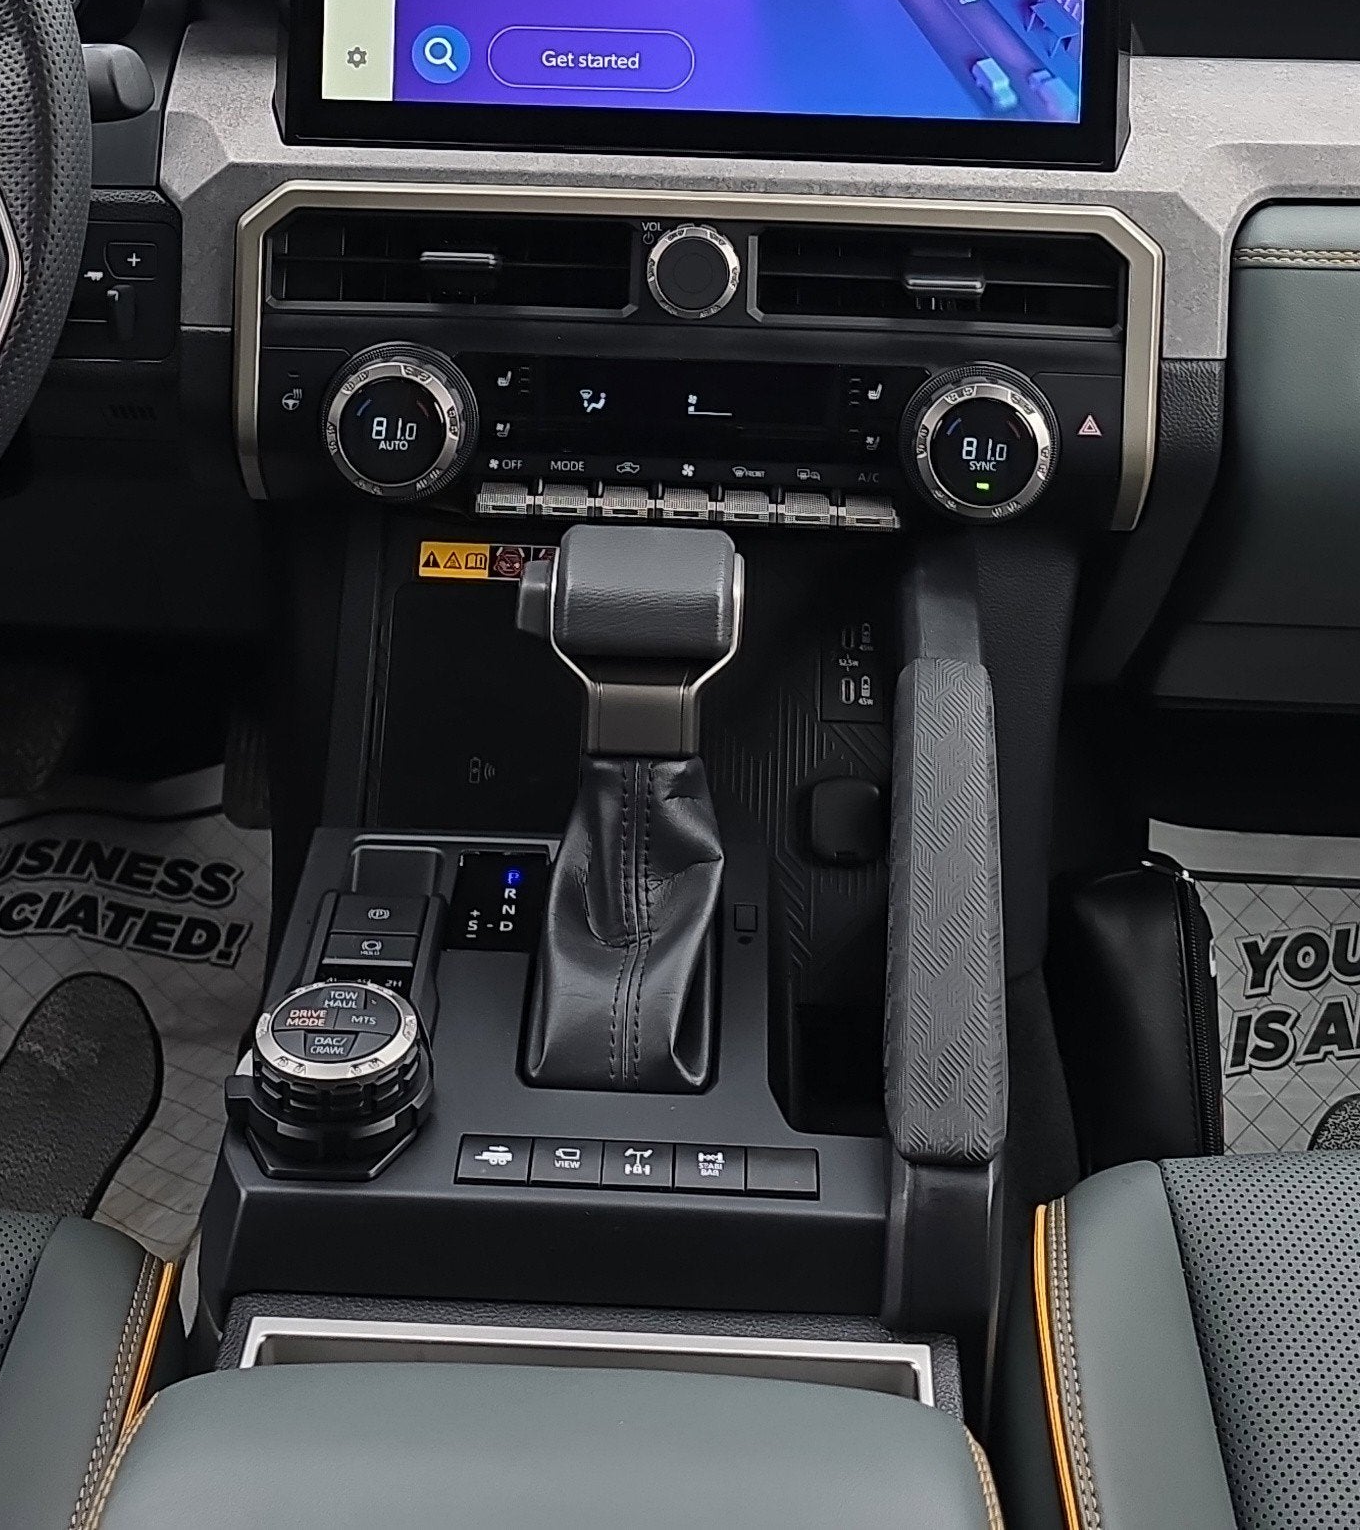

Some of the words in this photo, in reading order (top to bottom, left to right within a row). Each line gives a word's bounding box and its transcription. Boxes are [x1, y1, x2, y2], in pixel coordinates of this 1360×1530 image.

[542, 51, 574, 67] Get
[578, 53, 640, 69] started
[641, 222, 663, 231] VOL
[378, 440, 408, 450] AUTO
[502, 459, 523, 470] OFF
[550, 460, 585, 472] MODE
[969, 461, 997, 471] SYNC
[858, 473, 879, 483] A/C
[508, 872, 519, 884] P
[504, 888, 516, 899] R
[502, 904, 516, 915] N
[468, 920, 478, 931] S
[499, 921, 513, 931] D
[385, 979, 402, 988] 2H
[329, 991, 359, 1000] TOW
[323, 1000, 358, 1009] HAUL
[290, 1009, 327, 1018] DRIVE
[285, 1018, 326, 1027] MODE
[351, 1015, 377, 1025] MTS
[314, 1036, 348, 1045] DAC/
[1224, 1008, 1300, 1075] IS
[309, 1046, 345, 1055] CRAWL
[555, 1159, 580, 1169] VIEW
